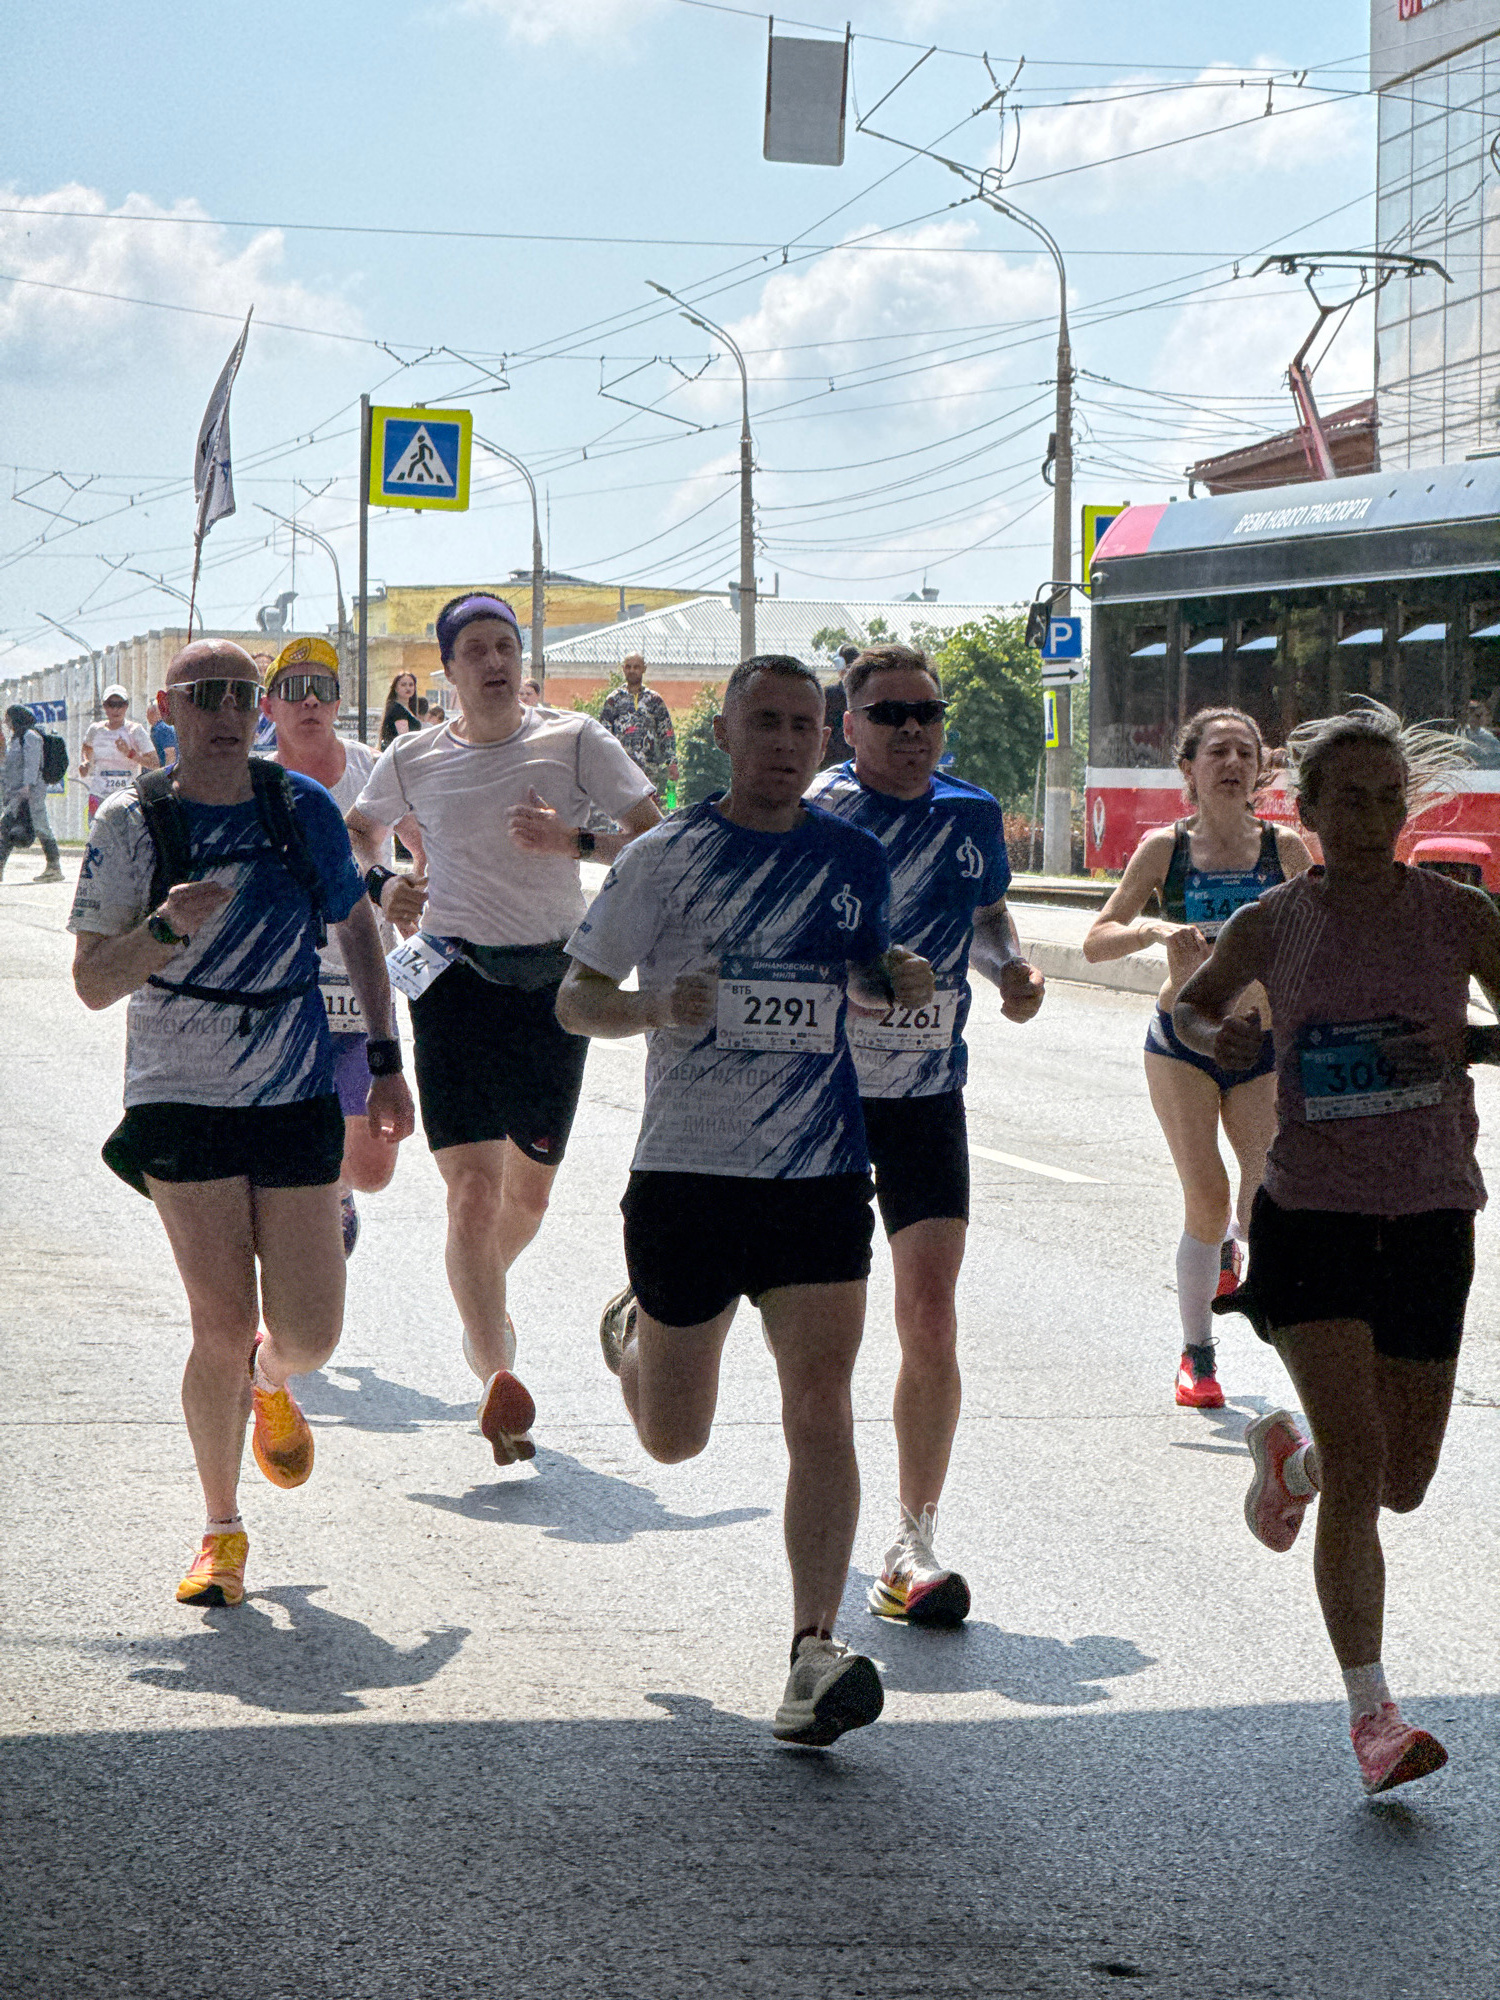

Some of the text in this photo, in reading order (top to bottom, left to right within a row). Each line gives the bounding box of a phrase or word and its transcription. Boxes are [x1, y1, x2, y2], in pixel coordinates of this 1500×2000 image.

[1233, 498, 1373, 534] ВРЕМЯ НОВОГО ТРАНСПОРТА
[1050, 622, 1073, 655] P
[752, 961, 815, 972] ДИНАМОВСКАЯ
[772, 971, 797, 980] МИЛЯ
[731, 985, 752, 995] ВТБ
[325, 995, 361, 1015] 110
[743, 996, 819, 1028] 2291
[879, 1004, 942, 1029] 2261
[1326, 1056, 1398, 1093] 309
